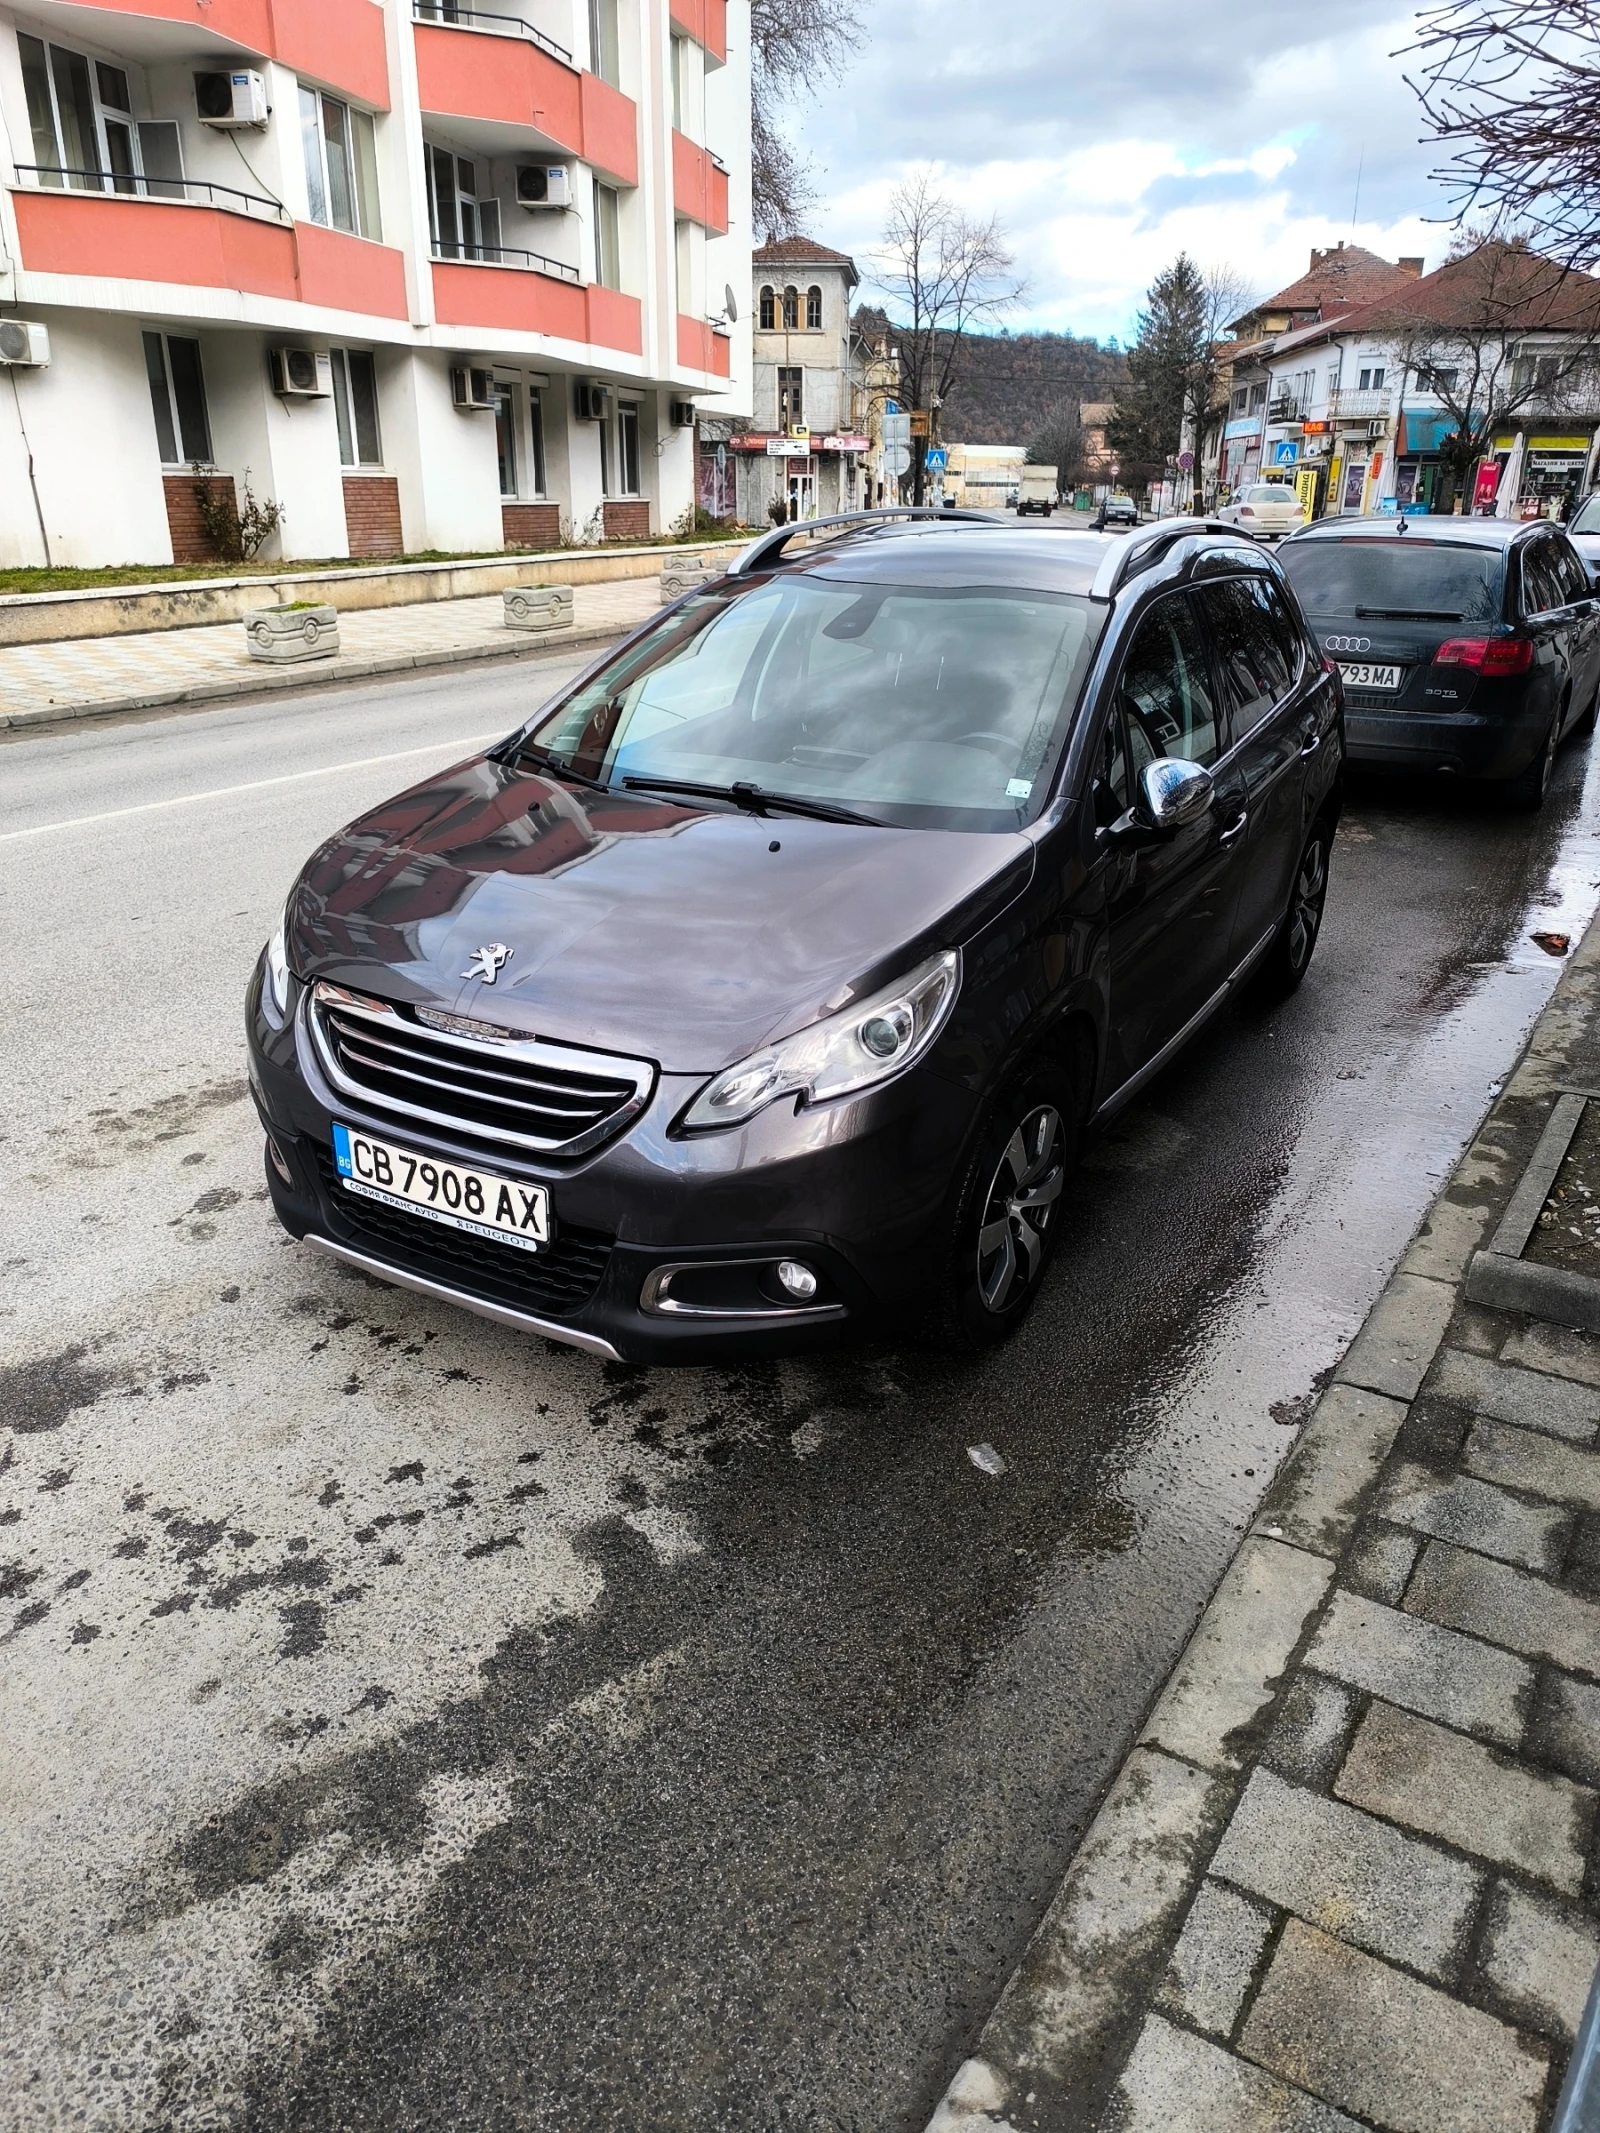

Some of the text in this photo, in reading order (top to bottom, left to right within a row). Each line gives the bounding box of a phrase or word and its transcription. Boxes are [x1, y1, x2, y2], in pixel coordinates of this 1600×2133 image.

[1372, 667, 1395, 686] MA
[338, 1155, 352, 1169] BG
[353, 1138, 542, 1235] CB 7908 AX
[349, 1181, 439, 1220] СОФИЯ ФРАНС АУТО
[465, 1222, 529, 1248] PEUGEOT
